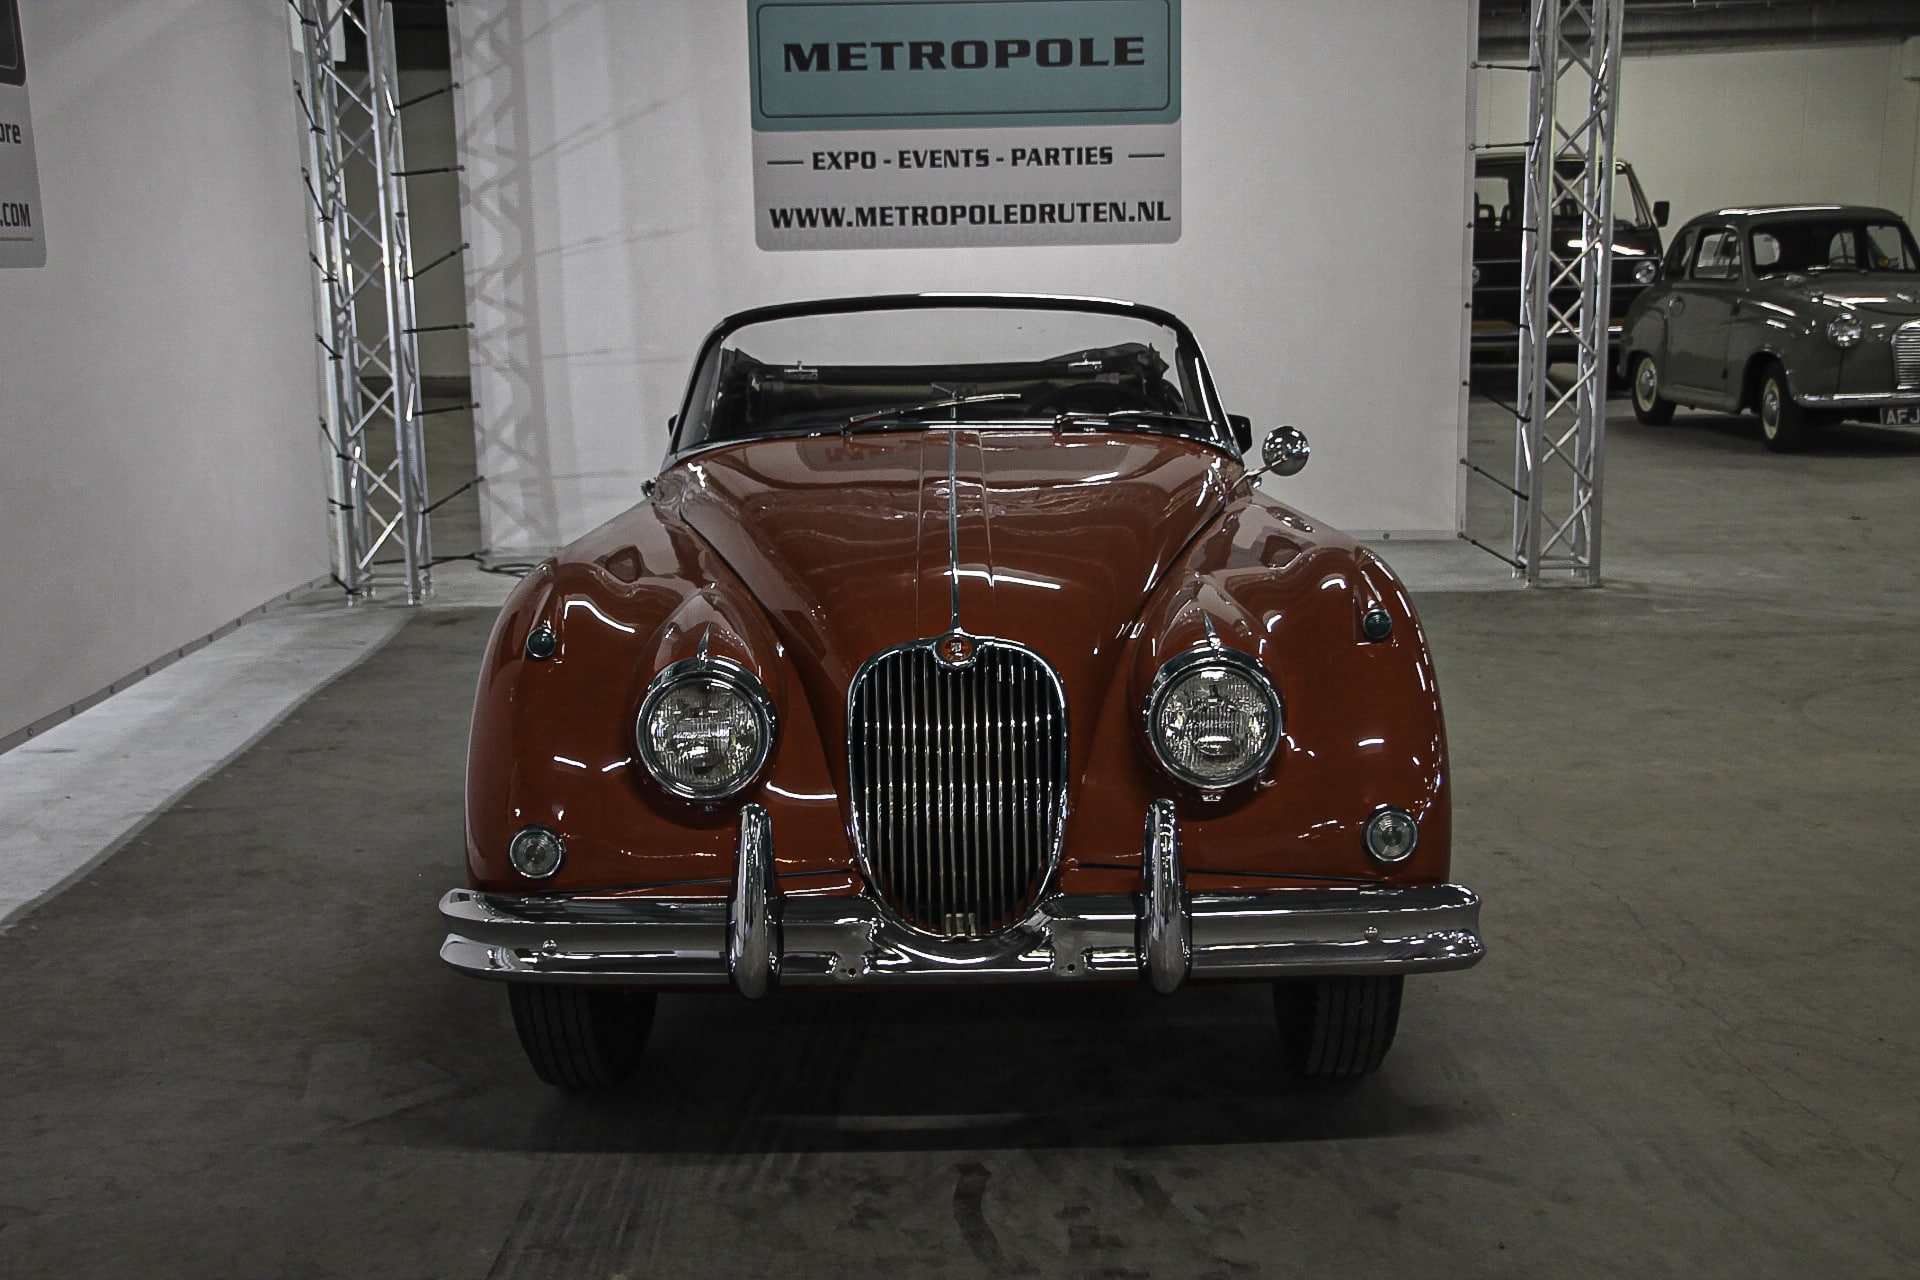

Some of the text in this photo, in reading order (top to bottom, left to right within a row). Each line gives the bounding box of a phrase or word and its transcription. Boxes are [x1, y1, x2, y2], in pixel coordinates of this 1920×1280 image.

[783, 37, 1146, 73] METROPOLE
[812, 150, 877, 171] EXPO
[898, 148, 990, 169] EVENTS
[1010, 146, 1114, 167] PARTIES
[769, 200, 1172, 229] WWW.METROPOLEDRUTEN.NL
